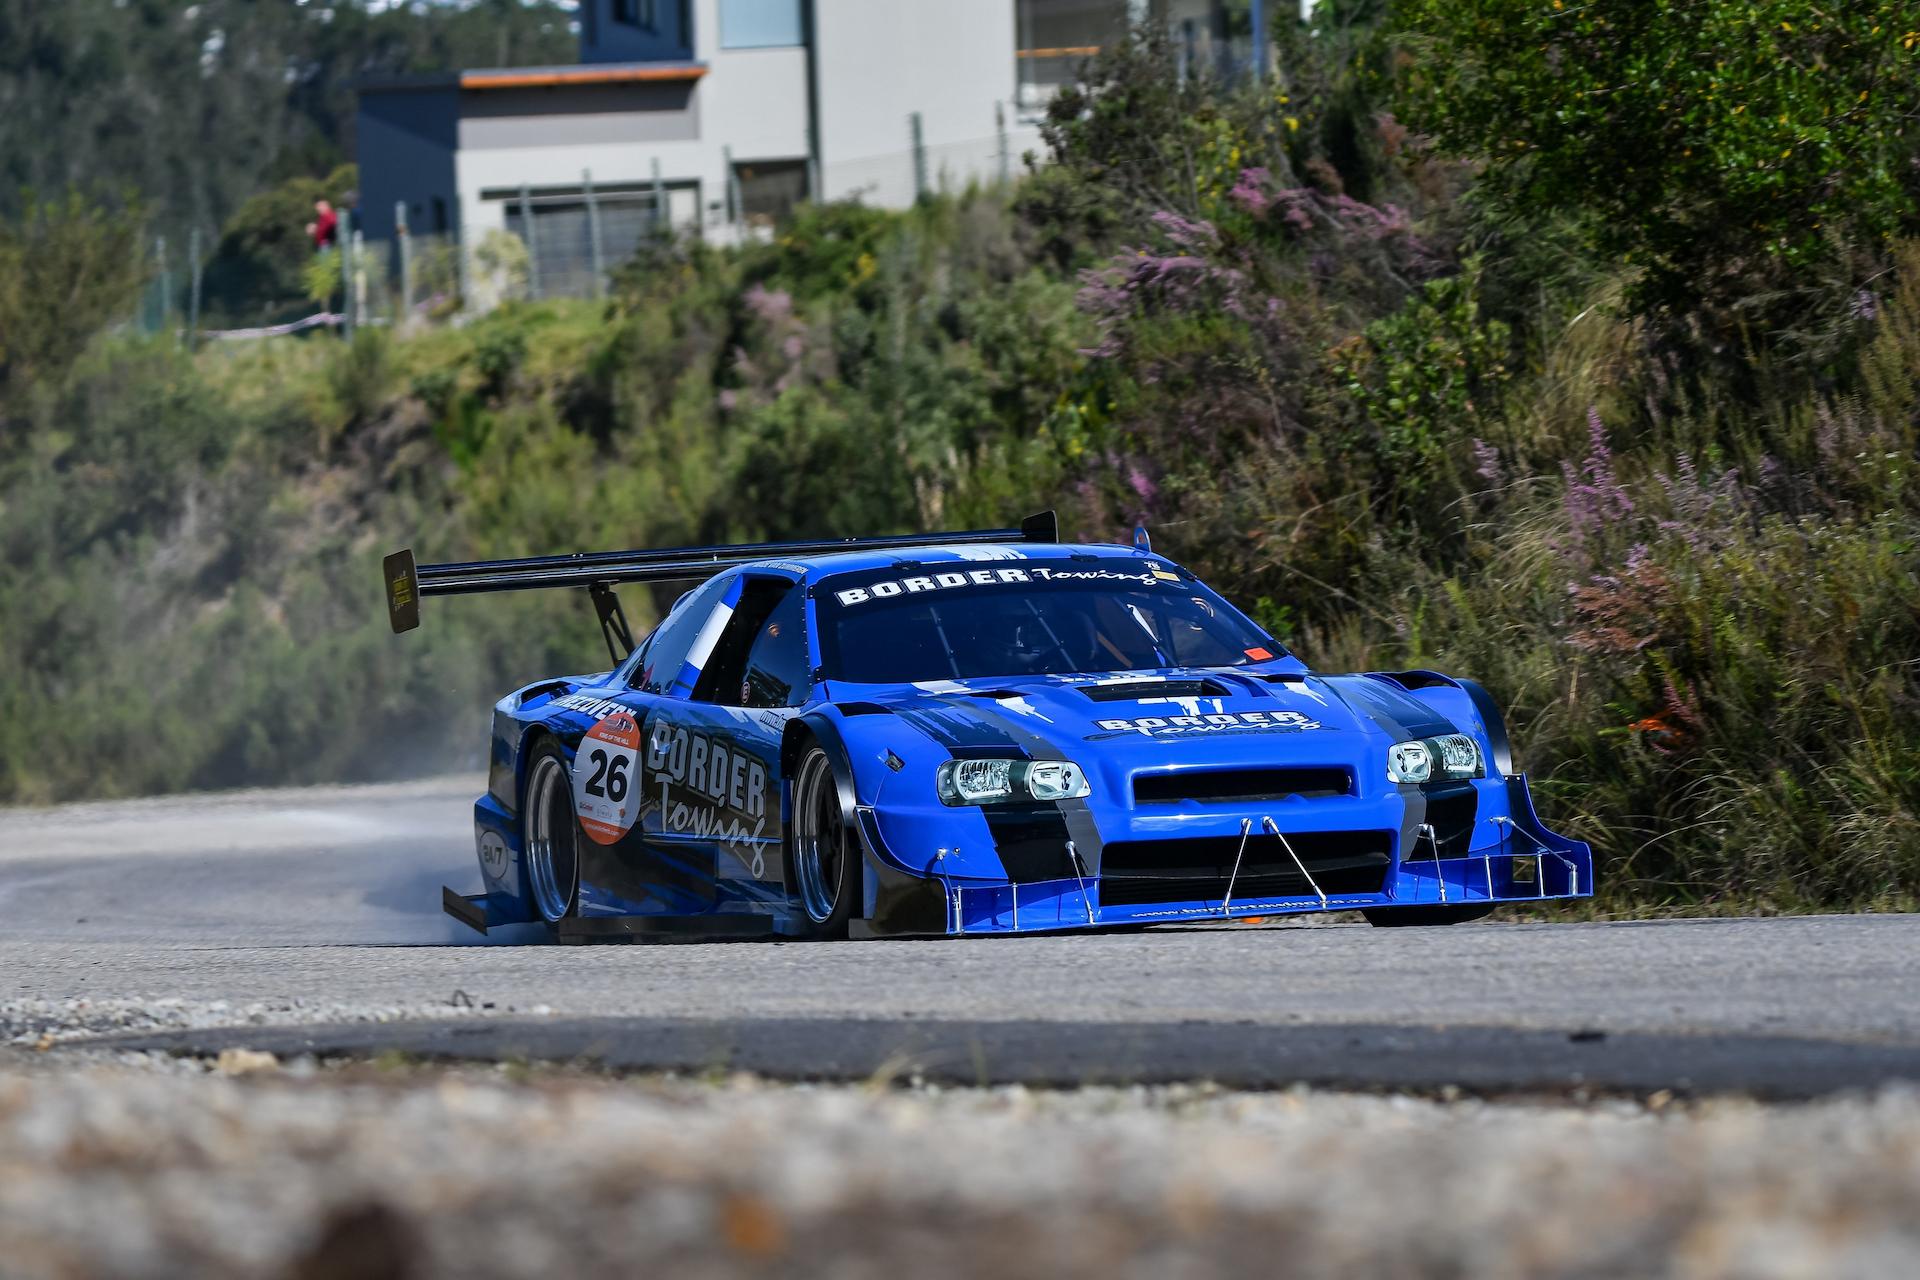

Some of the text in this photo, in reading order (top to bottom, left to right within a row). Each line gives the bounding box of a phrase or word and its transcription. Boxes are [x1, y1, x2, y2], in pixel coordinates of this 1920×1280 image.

[838, 568, 1157, 606] BORDER Towing
[1097, 711, 1310, 730] BORDER
[1123, 720, 1321, 736] Towing
[585, 749, 630, 803] 26
[647, 717, 767, 818] BORDER
[655, 772, 768, 878] Towing
